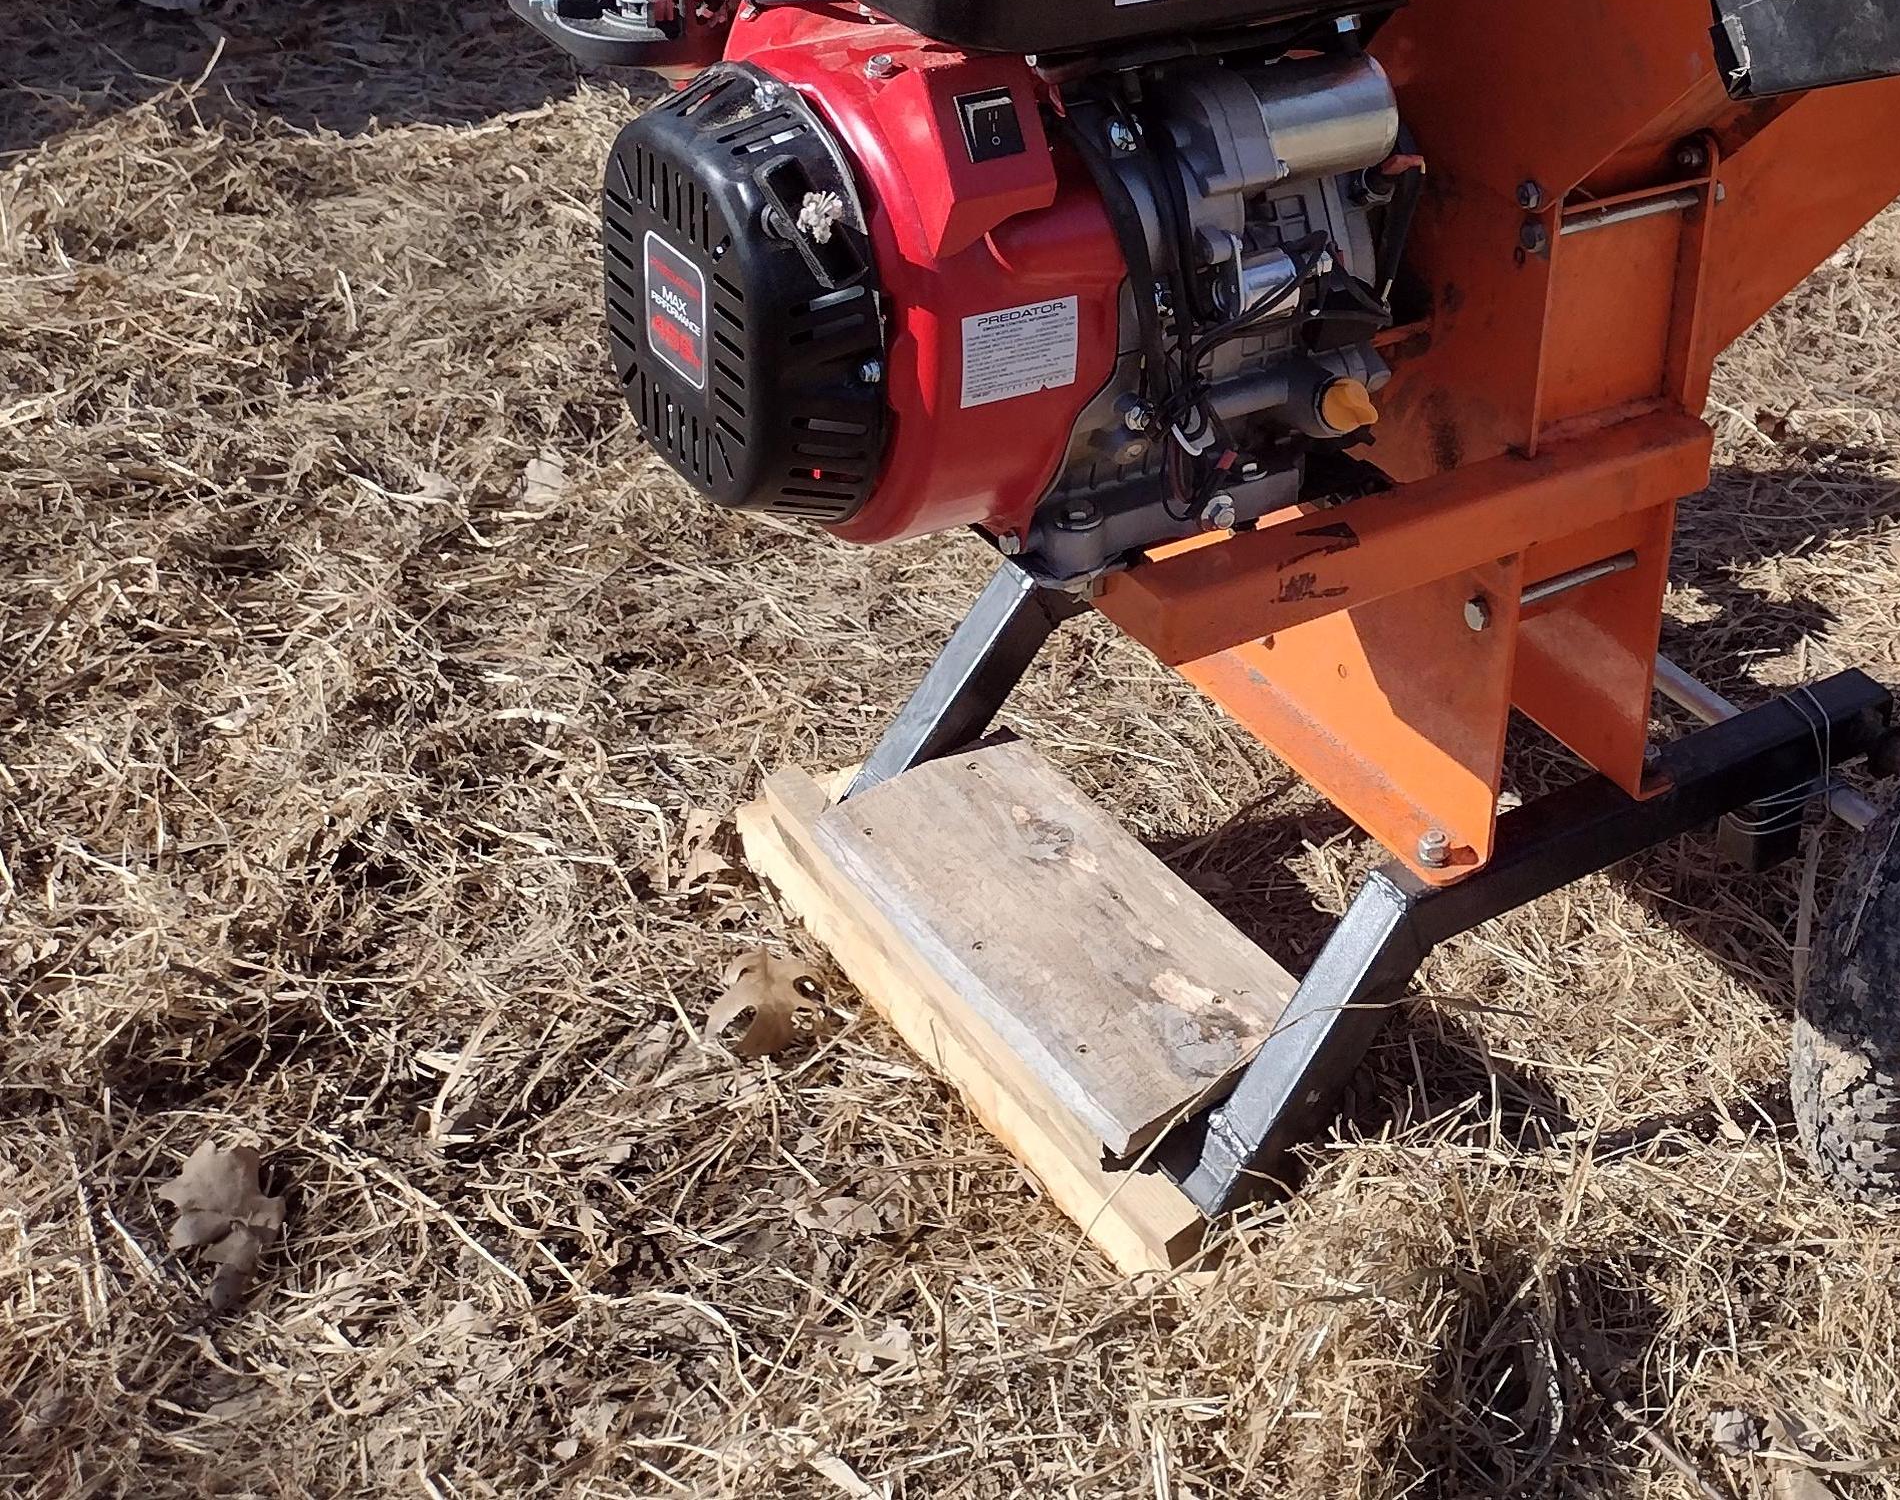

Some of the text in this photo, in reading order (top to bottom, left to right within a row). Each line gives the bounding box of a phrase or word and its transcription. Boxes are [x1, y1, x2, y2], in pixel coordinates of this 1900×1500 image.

[651, 290, 700, 337] PERFORMANCE
[662, 285, 687, 315] MAX
[978, 302, 1064, 326] PREDATOR
